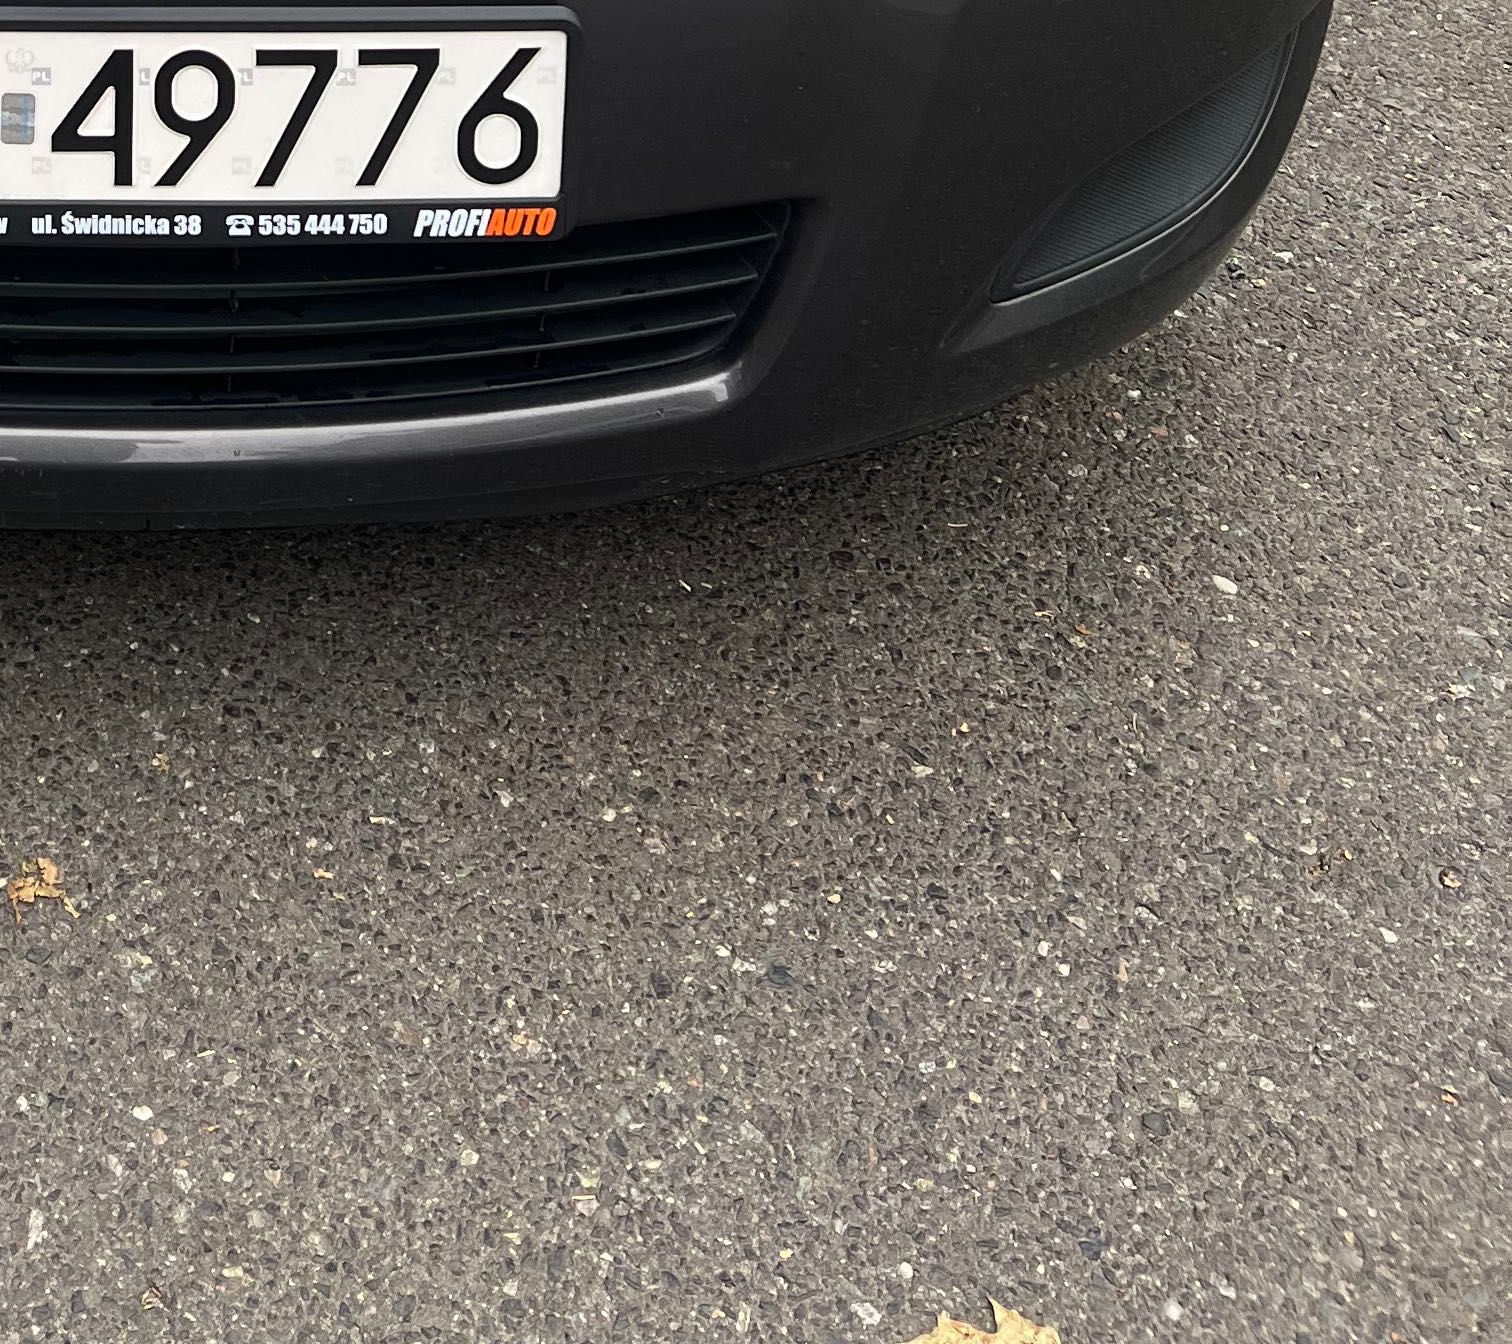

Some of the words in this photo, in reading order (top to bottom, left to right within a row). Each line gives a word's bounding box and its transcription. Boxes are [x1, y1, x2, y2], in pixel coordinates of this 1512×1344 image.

[50, 47, 542, 187] 49776
[31, 214, 58, 235] ul.
[61, 210, 171, 235] Świdnicka
[173, 214, 203, 236] 38
[258, 214, 302, 237] 535
[304, 214, 346, 235] 444
[348, 213, 388, 235] 750
[412, 207, 558, 238] PROFIAUTO
